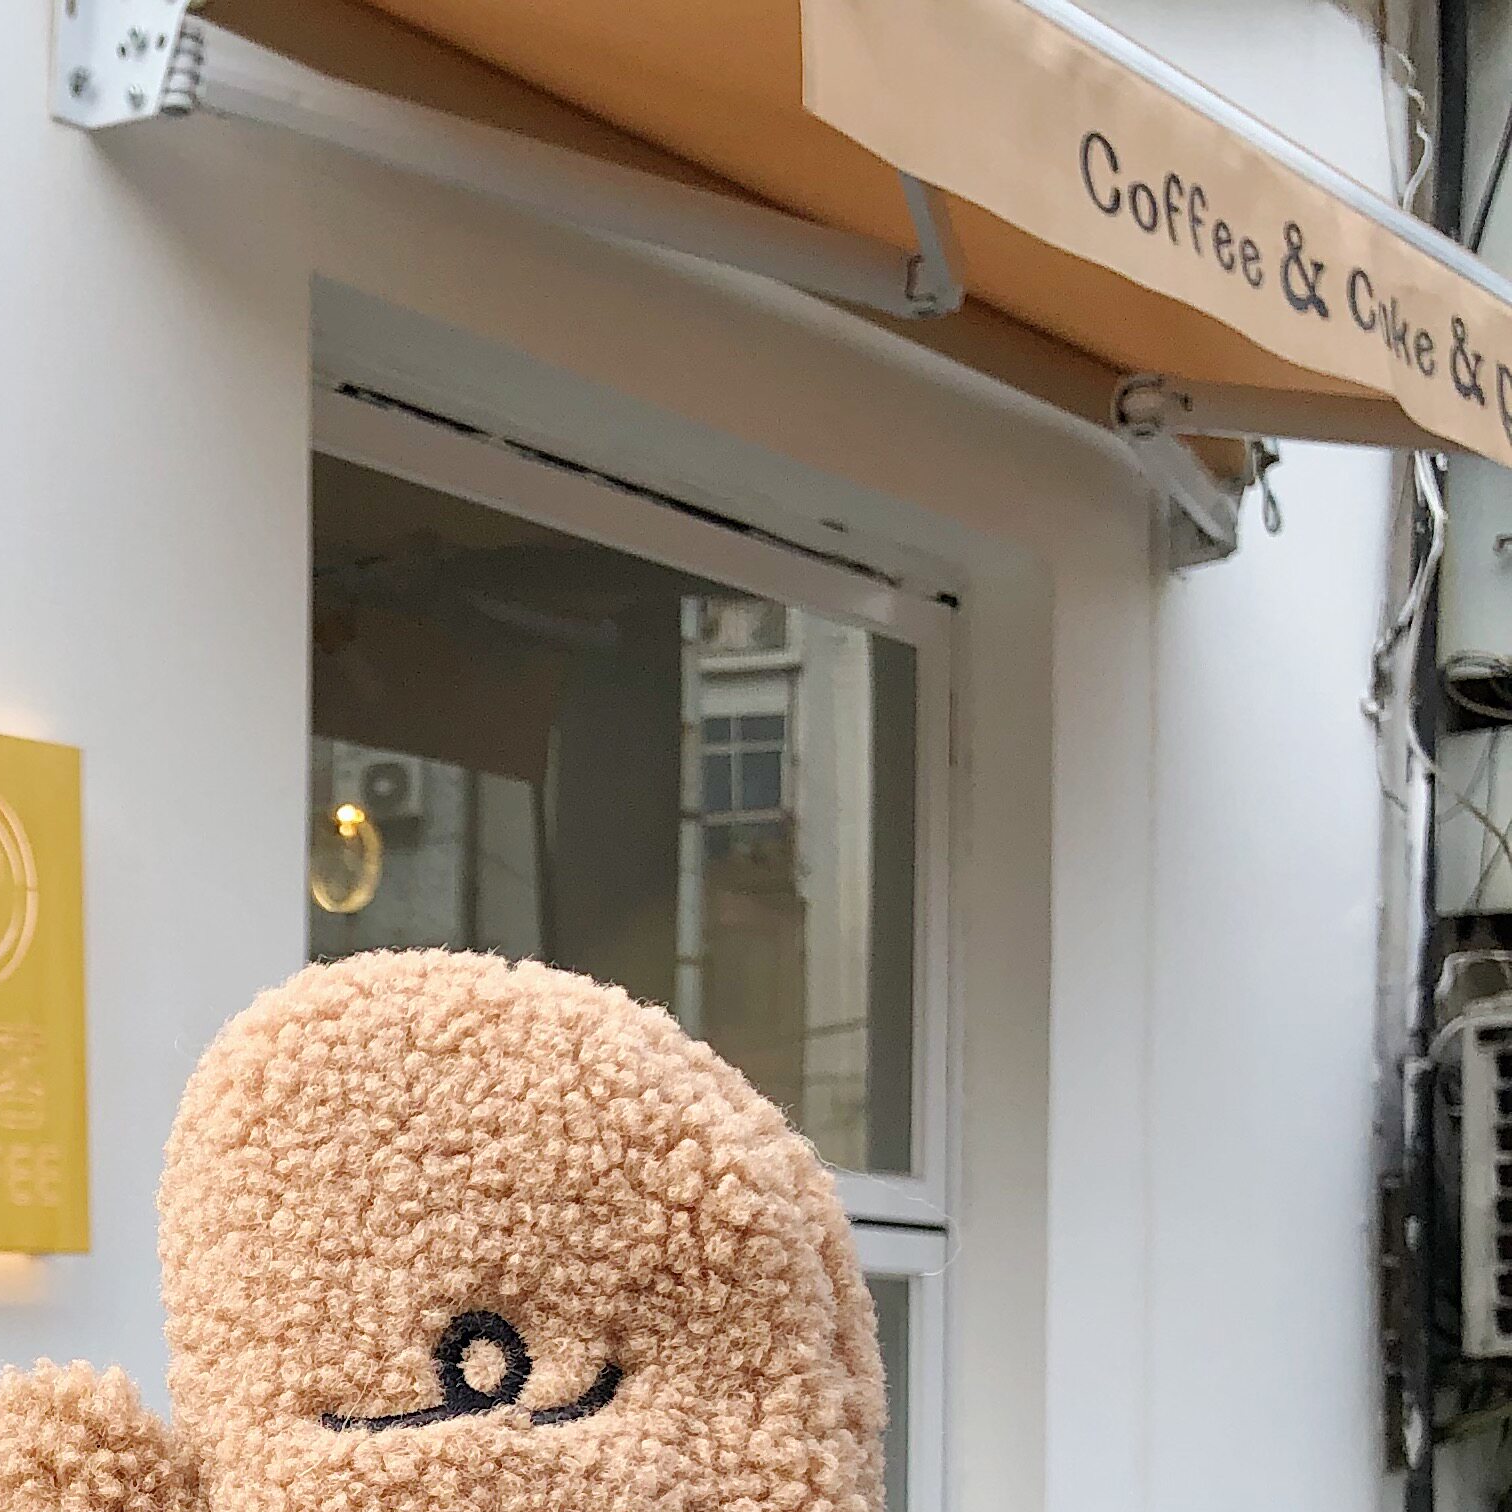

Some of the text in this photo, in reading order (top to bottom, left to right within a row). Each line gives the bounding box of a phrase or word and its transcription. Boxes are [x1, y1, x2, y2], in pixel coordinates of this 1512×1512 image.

[1079, 130, 1263, 289] Coffee
[1281, 221, 1330, 319] &
[1450, 315, 1485, 406] &
